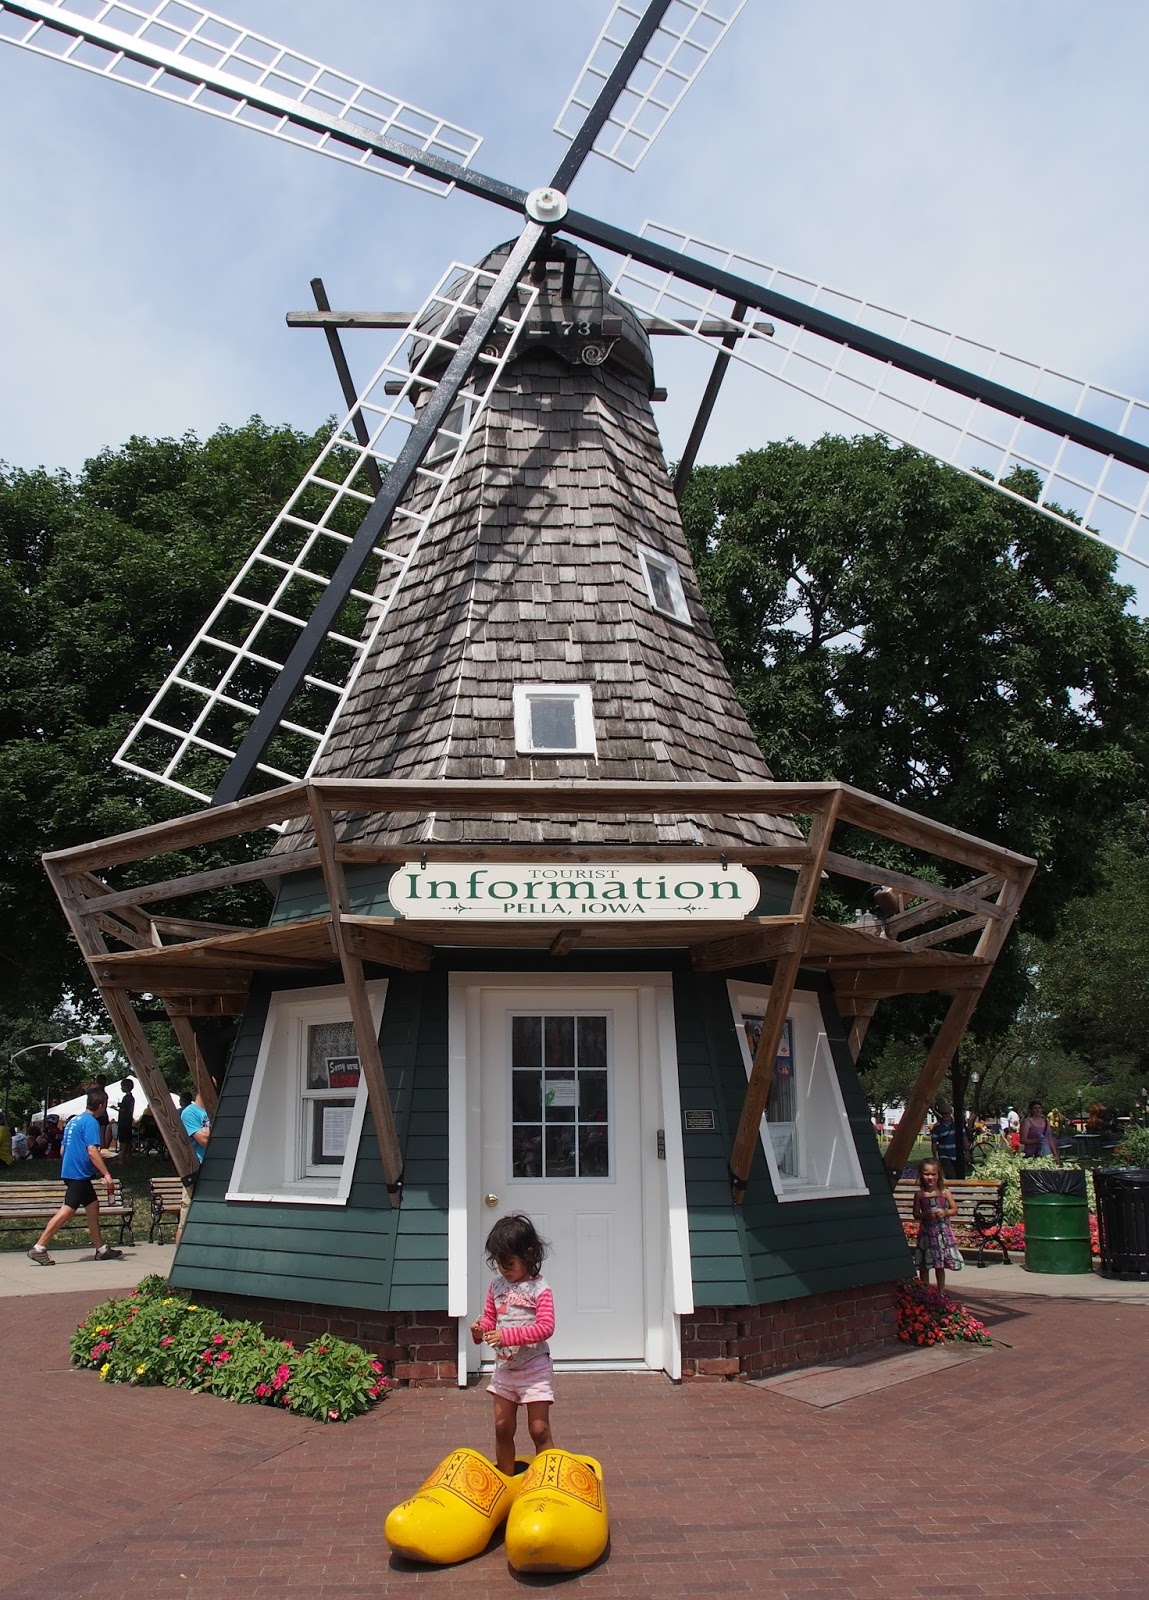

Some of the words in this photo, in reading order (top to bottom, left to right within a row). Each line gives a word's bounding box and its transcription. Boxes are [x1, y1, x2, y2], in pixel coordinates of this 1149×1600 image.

[528, 869, 620, 879] TOURIST
[405, 870, 742, 900] Information
[503, 903, 572, 916] PELLA,
[581, 903, 646, 914] IOWA
